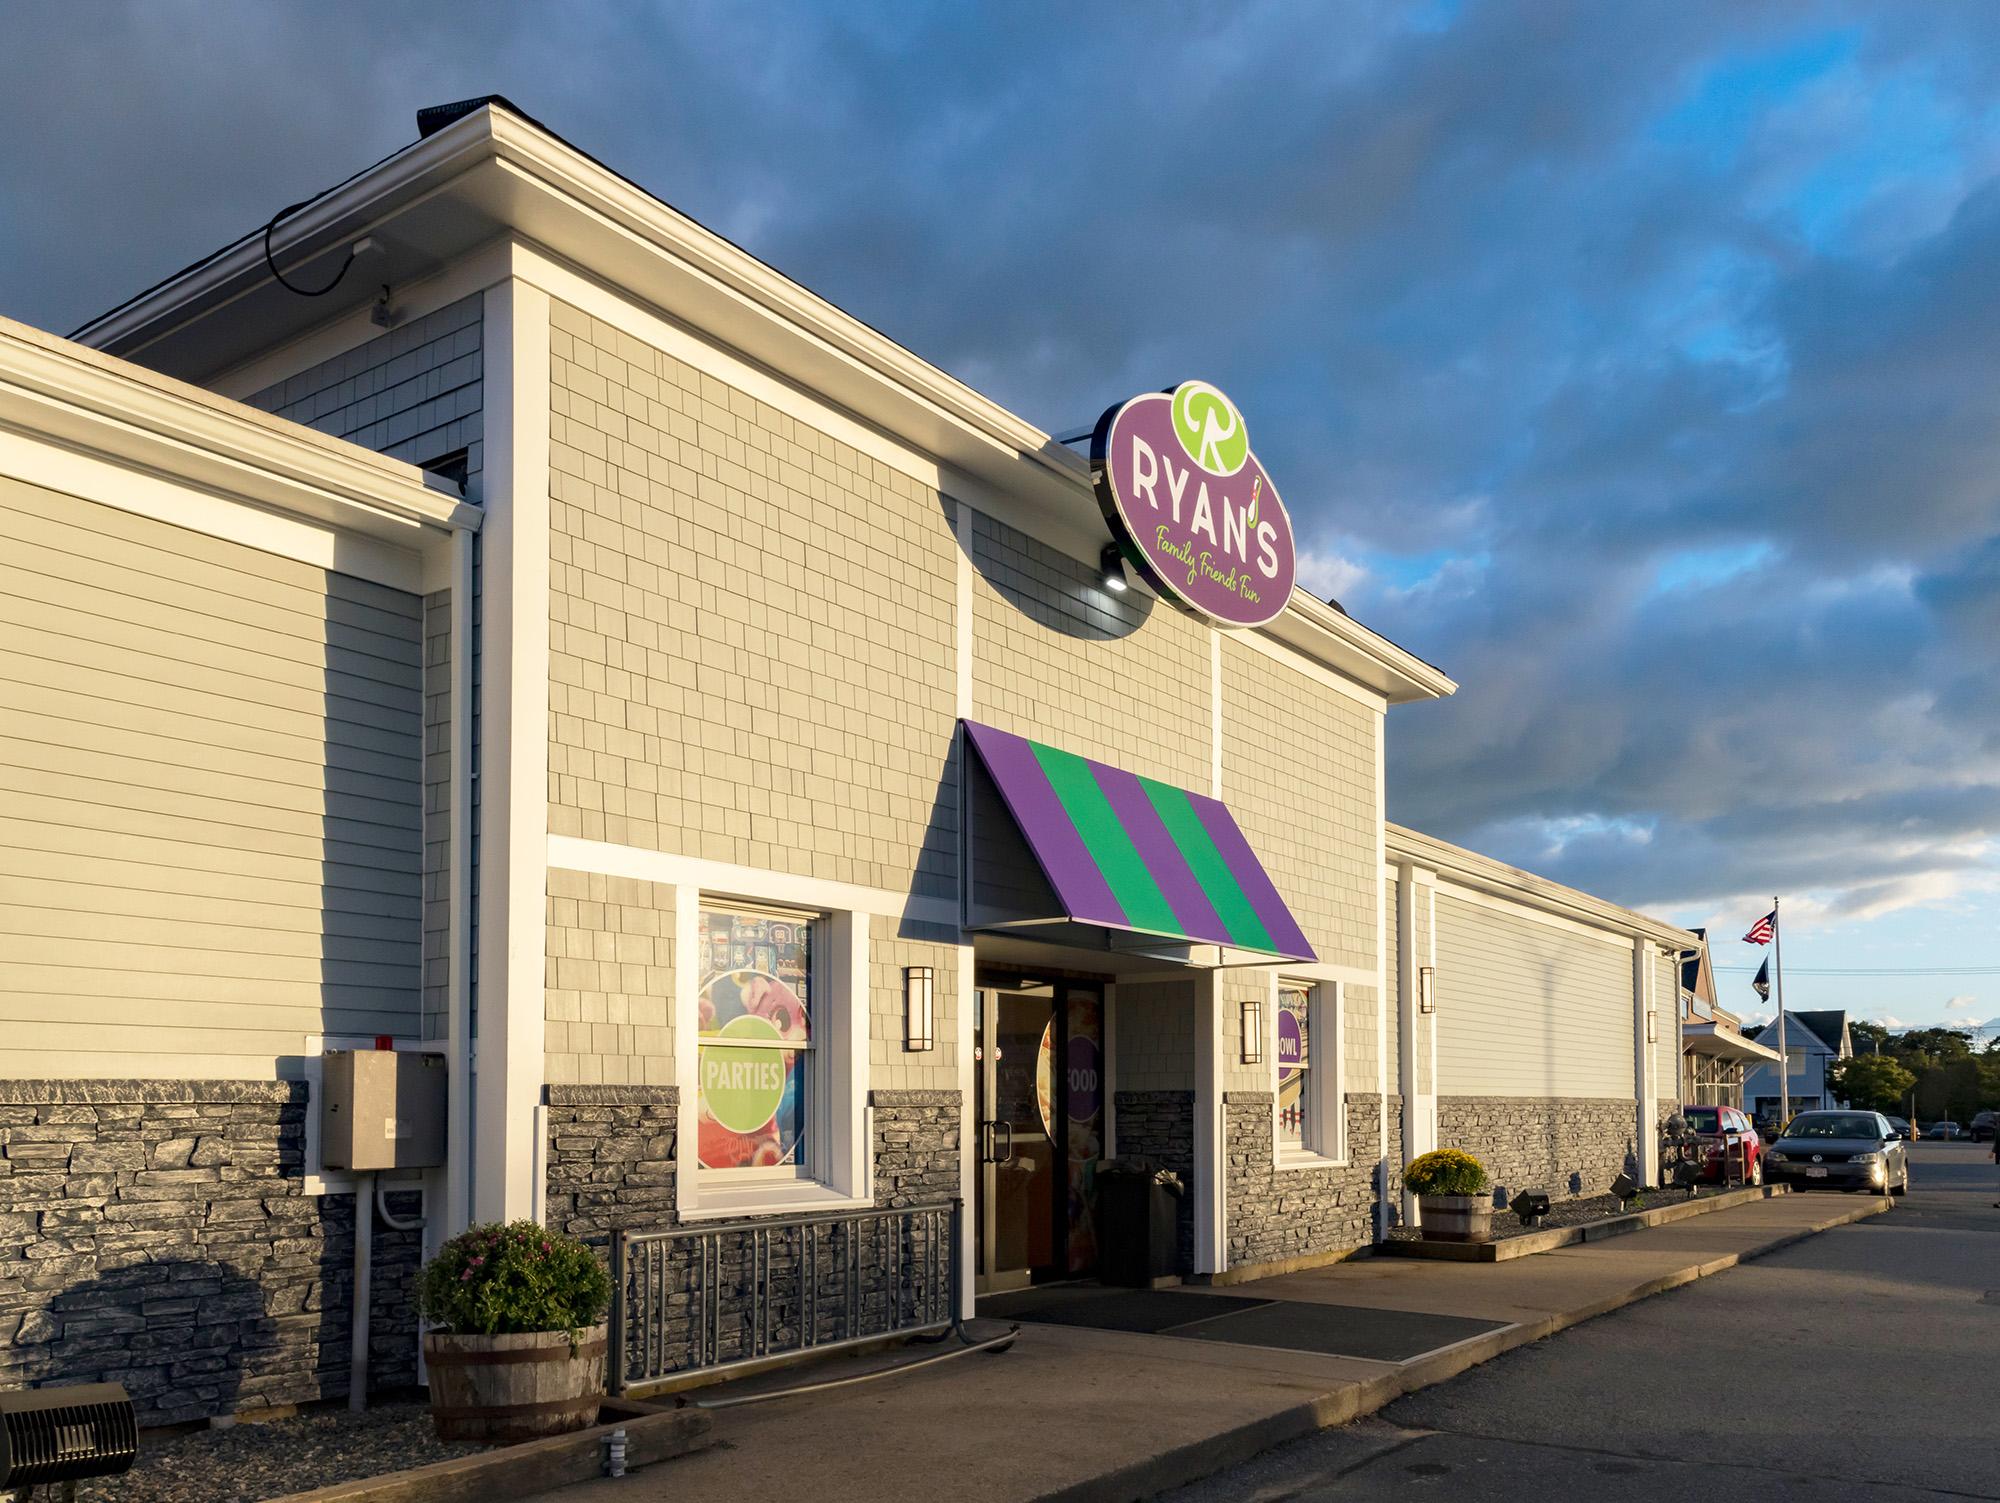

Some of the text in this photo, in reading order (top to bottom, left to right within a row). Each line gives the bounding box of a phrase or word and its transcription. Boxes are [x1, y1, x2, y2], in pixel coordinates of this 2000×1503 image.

[1133, 434, 1278, 579] RYAN'S
[1156, 525, 1260, 604] Family Friends Fun
[1279, 1037, 1297, 1056] OWL
[706, 1060, 780, 1090] PARTIES
